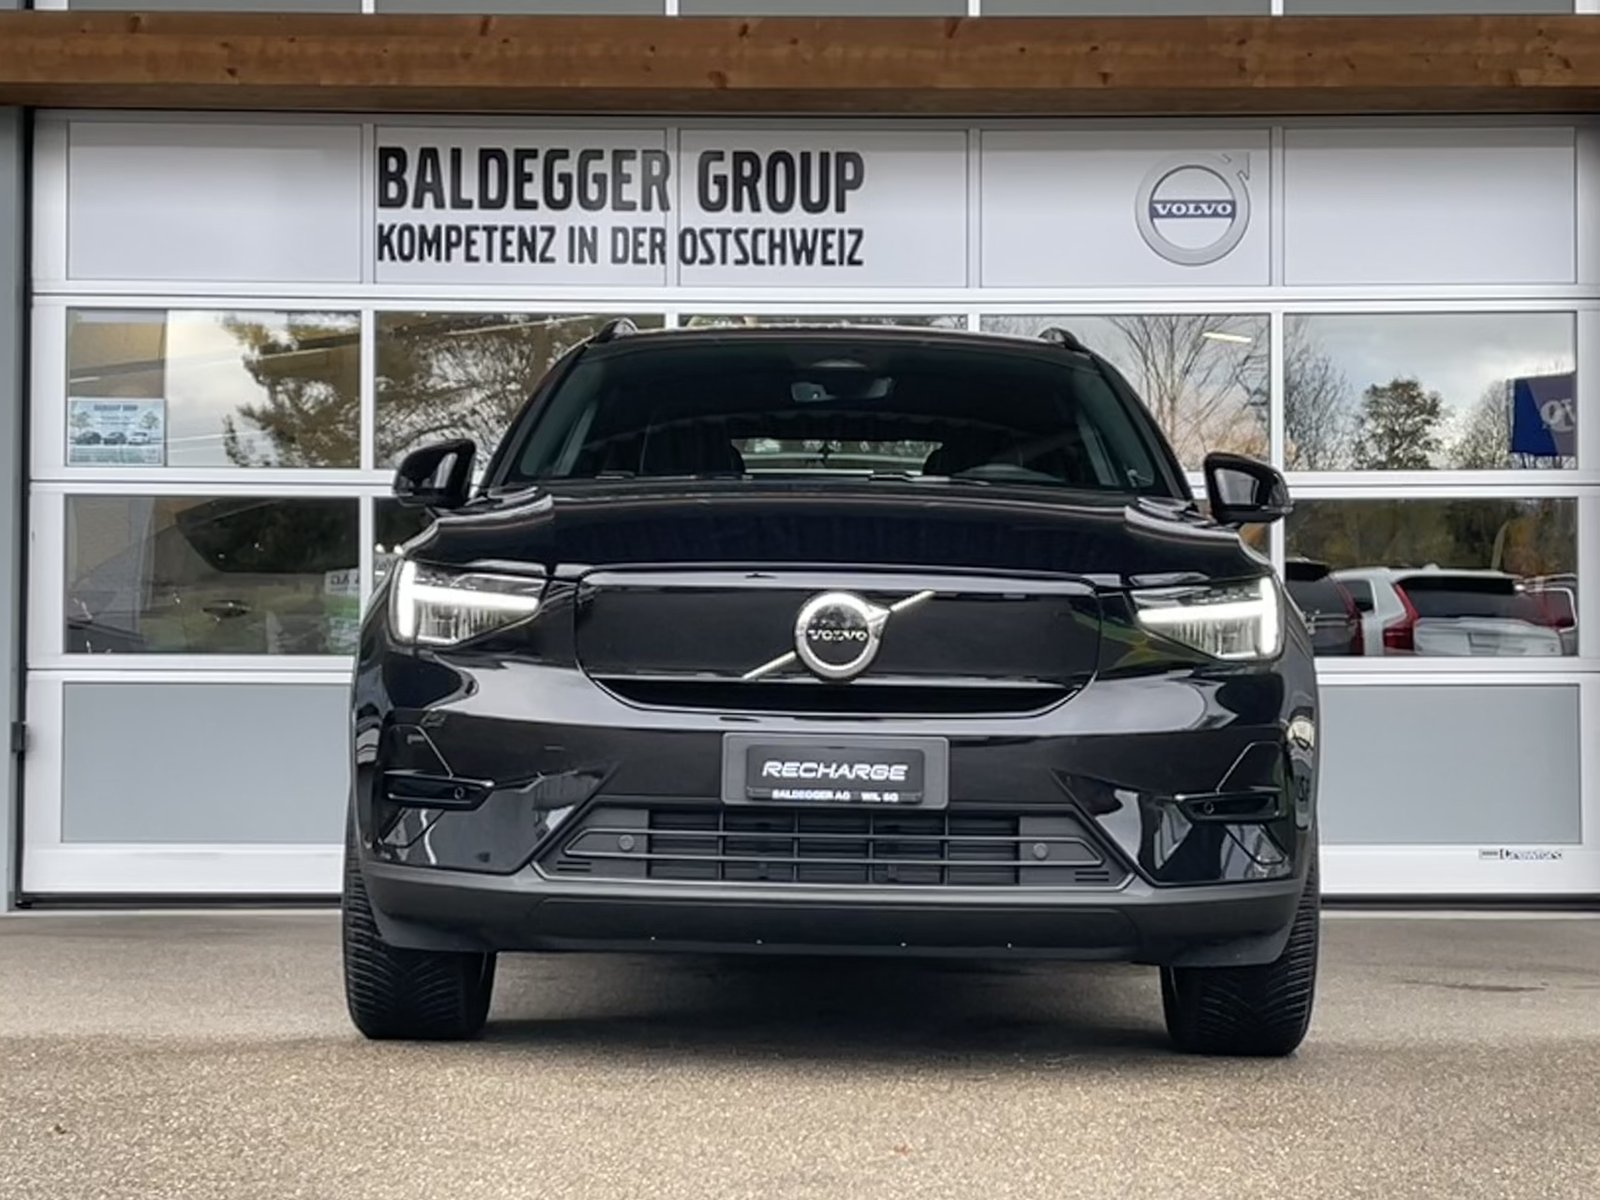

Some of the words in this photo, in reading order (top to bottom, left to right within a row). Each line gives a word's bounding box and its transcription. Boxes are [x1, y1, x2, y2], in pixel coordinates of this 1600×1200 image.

[377, 146, 671, 212] BALDEGGER
[699, 150, 865, 214] GROUP
[1152, 203, 1232, 215] VOLVO
[377, 223, 556, 264] KOMPETENZ
[568, 226, 598, 264] IN
[610, 227, 666, 266] DER
[678, 227, 865, 267] OSTSCHWEIZ
[807, 629, 868, 641] VOLVO
[762, 760, 908, 781] RECHARGE
